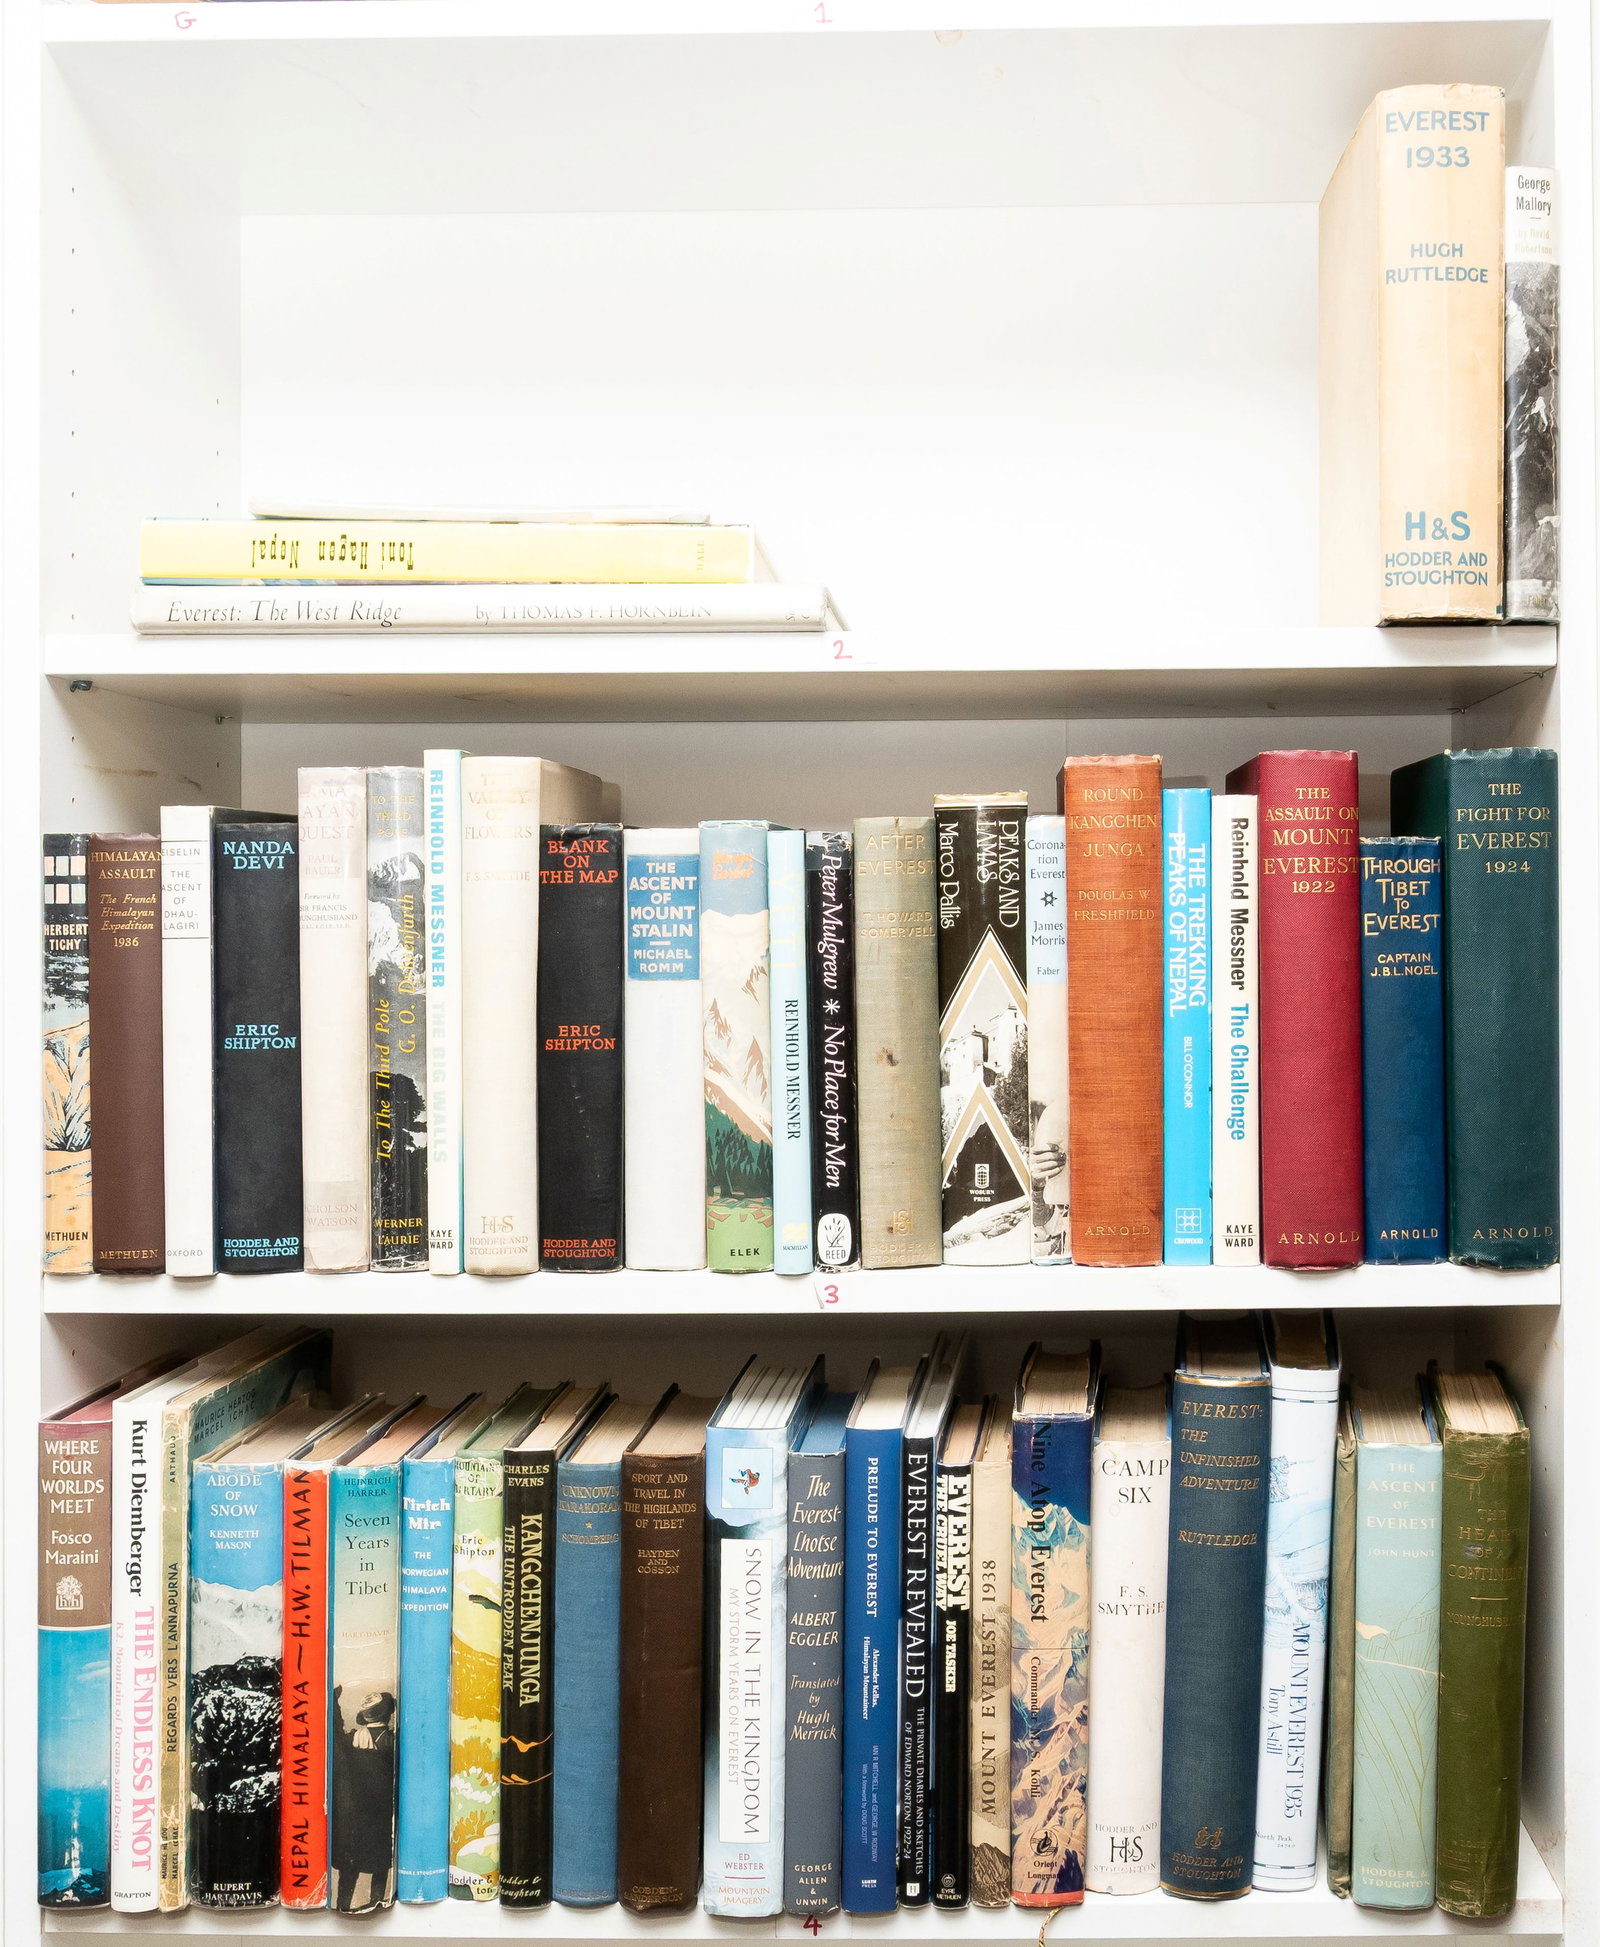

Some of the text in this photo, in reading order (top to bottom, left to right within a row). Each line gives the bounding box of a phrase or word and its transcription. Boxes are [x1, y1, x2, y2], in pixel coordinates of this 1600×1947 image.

[175, 10, 197, 29] G
[1386, 110, 1490, 133] EVEREST
[1407, 146, 1469, 168] 1933
[1518, 175, 1551, 193] George
[1516, 196, 1552, 215] Mallory
[1410, 243, 1463, 258] HUGH
[1386, 266, 1488, 284] RUTTLEDGE
[1385, 552, 1487, 568] HODDER AND
[1385, 570, 1488, 587] STOUGHTON
[833, 640, 852, 660] 2
[1084, 788, 1143, 803] ROUND
[1296, 787, 1330, 799] THE
[1488, 783, 1521, 796] THE
[1457, 806, 1551, 822] FIGHT FOR
[1272, 828, 1353, 845] MOUNT
[1457, 832, 1552, 850] EVEREST
[223, 841, 295, 855] NANDA
[547, 840, 609, 853] BLANK
[1083, 843, 1145, 857] JUNGA
[233, 856, 284, 870] DEVI
[563, 855, 589, 868] ON
[646, 862, 676, 873] THE
[1263, 857, 1360, 876] EVEREST
[1485, 860, 1530, 873] 1924
[99, 869, 156, 879] ASSAULT
[430, 770, 445, 988] REINHOLD MESSNER
[540, 870, 618, 884] THE MAP
[1031, 869, 1065, 879] Everest
[629, 877, 697, 890] ASCENT
[1292, 880, 1336, 893] 1922
[650, 893, 671, 905] OF
[631, 906, 695, 920] MOUNT
[1074, 909, 1155, 921] FRESHFIELD
[632, 923, 693, 937] STALIN
[1034, 921, 1063, 932] James
[1188, 843, 1207, 1007] THE TREKKING
[49, 938, 80, 950] TICHY
[1031, 935, 1065, 945] Morris
[634, 949, 692, 960] MICHAEL
[1378, 953, 1431, 963] CAPTAIN
[639, 963, 684, 973] ROMM
[1226, 817, 1249, 1140] Reinhold Messner The Challenge
[235, 1024, 279, 1036] ERIC
[558, 1025, 601, 1036] ERIC
[224, 1036, 296, 1050] SHIPTON
[545, 1038, 616, 1051] SHIPTON
[785, 999, 800, 1140] REINHOLD MESSNER
[430, 1229, 453, 1238] KAYE
[1084, 1226, 1150, 1236] ARNOLD
[1226, 1224, 1253, 1234] KAYE
[1380, 1228, 1439, 1240] ARNOLD
[1473, 1226, 1554, 1239] ARNOLD
[224, 1237, 299, 1248] HODDER AND
[543, 1238, 616, 1248] HODDER AND
[1225, 1237, 1254, 1247] WARD
[1278, 1230, 1360, 1244] ARNOLD
[430, 1241, 453, 1249] WARD
[100, 1249, 158, 1259] METHUEN
[224, 1247, 299, 1258] STOUGHTON
[543, 1247, 615, 1258] STOUGHTON
[730, 1248, 760, 1257] ELEK
[824, 1285, 839, 1304] 3
[45, 1440, 100, 1455] WHERE
[52, 1460, 93, 1475] FOUR
[504, 1464, 550, 1474] CHARLES
[1102, 1459, 1169, 1476] CAMP
[1389, 1463, 1415, 1473] THE
[207, 1475, 262, 1487] ABODE
[344, 1477, 391, 1486] HEINRICH
[508, 1477, 544, 1486] EVANS
[632, 1474, 688, 1484] SPORT AND
[1179, 1477, 1260, 1491] ADVENTURE
[42, 1479, 104, 1494] WORLDS
[1367, 1480, 1438, 1492] ASCENT
[225, 1491, 241, 1501] OF
[348, 1489, 387, 1497] HARRER
[634, 1488, 686, 1499] TRAVEL IN
[1118, 1487, 1152, 1504] SIX
[50, 1499, 94, 1514] MEET
[126, 1420, 147, 1597] Kurt Diemberger
[211, 1504, 258, 1517] SNOW
[624, 1502, 697, 1513] THE HIGHLANDS
[1393, 1501, 1409, 1510] OF
[345, 1514, 390, 1527] Seven
[635, 1519, 684, 1529] OF TIBET
[1367, 1518, 1437, 1529] EVEREST
[51, 1530, 92, 1545] Fosco
[209, 1529, 259, 1539] KENNETH
[462, 1535, 482, 1544] Eric
[867, 1457, 879, 1617] PRELUDE TO EVEREST
[215, 1540, 251, 1550] MASON
[345, 1536, 389, 1549] Years
[46, 1550, 99, 1565] Maraini
[360, 1558, 374, 1571] in
[905, 1453, 928, 1698] EVEREST REVEALED
[345, 1582, 388, 1595] Tibet
[791, 1611, 837, 1626] ALBERT
[789, 1631, 838, 1646] EGGLER
[167, 1562, 178, 1753] REGARDS VERS L'ANNAPURNA
[946, 1620, 957, 1693] JOE TASKER
[743, 1548, 762, 1835] SNOW IN THE KINGDOM
[982, 1560, 997, 1815] MOUNT EVEREST 1938
[809, 1692, 821, 1706] by
[131, 1606, 157, 1872] THE ENDLESS KNOT
[790, 1725, 837, 1741] Merrick
[916, 1706, 925, 1875] THE PRIVATE DIARIES AND SKETCHES
[738, 1852, 750, 1861] ED
[725, 1862, 764, 1870] WEBSTER
[794, 1863, 832, 1873] GEORGE
[214, 1883, 252, 1891] RUPERT
[798, 1876, 827, 1885] ALLEN
[724, 1896, 763, 1905] IMAGERY
[796, 1897, 828, 1906] UNWIN
[803, 1914, 822, 1936] 4
